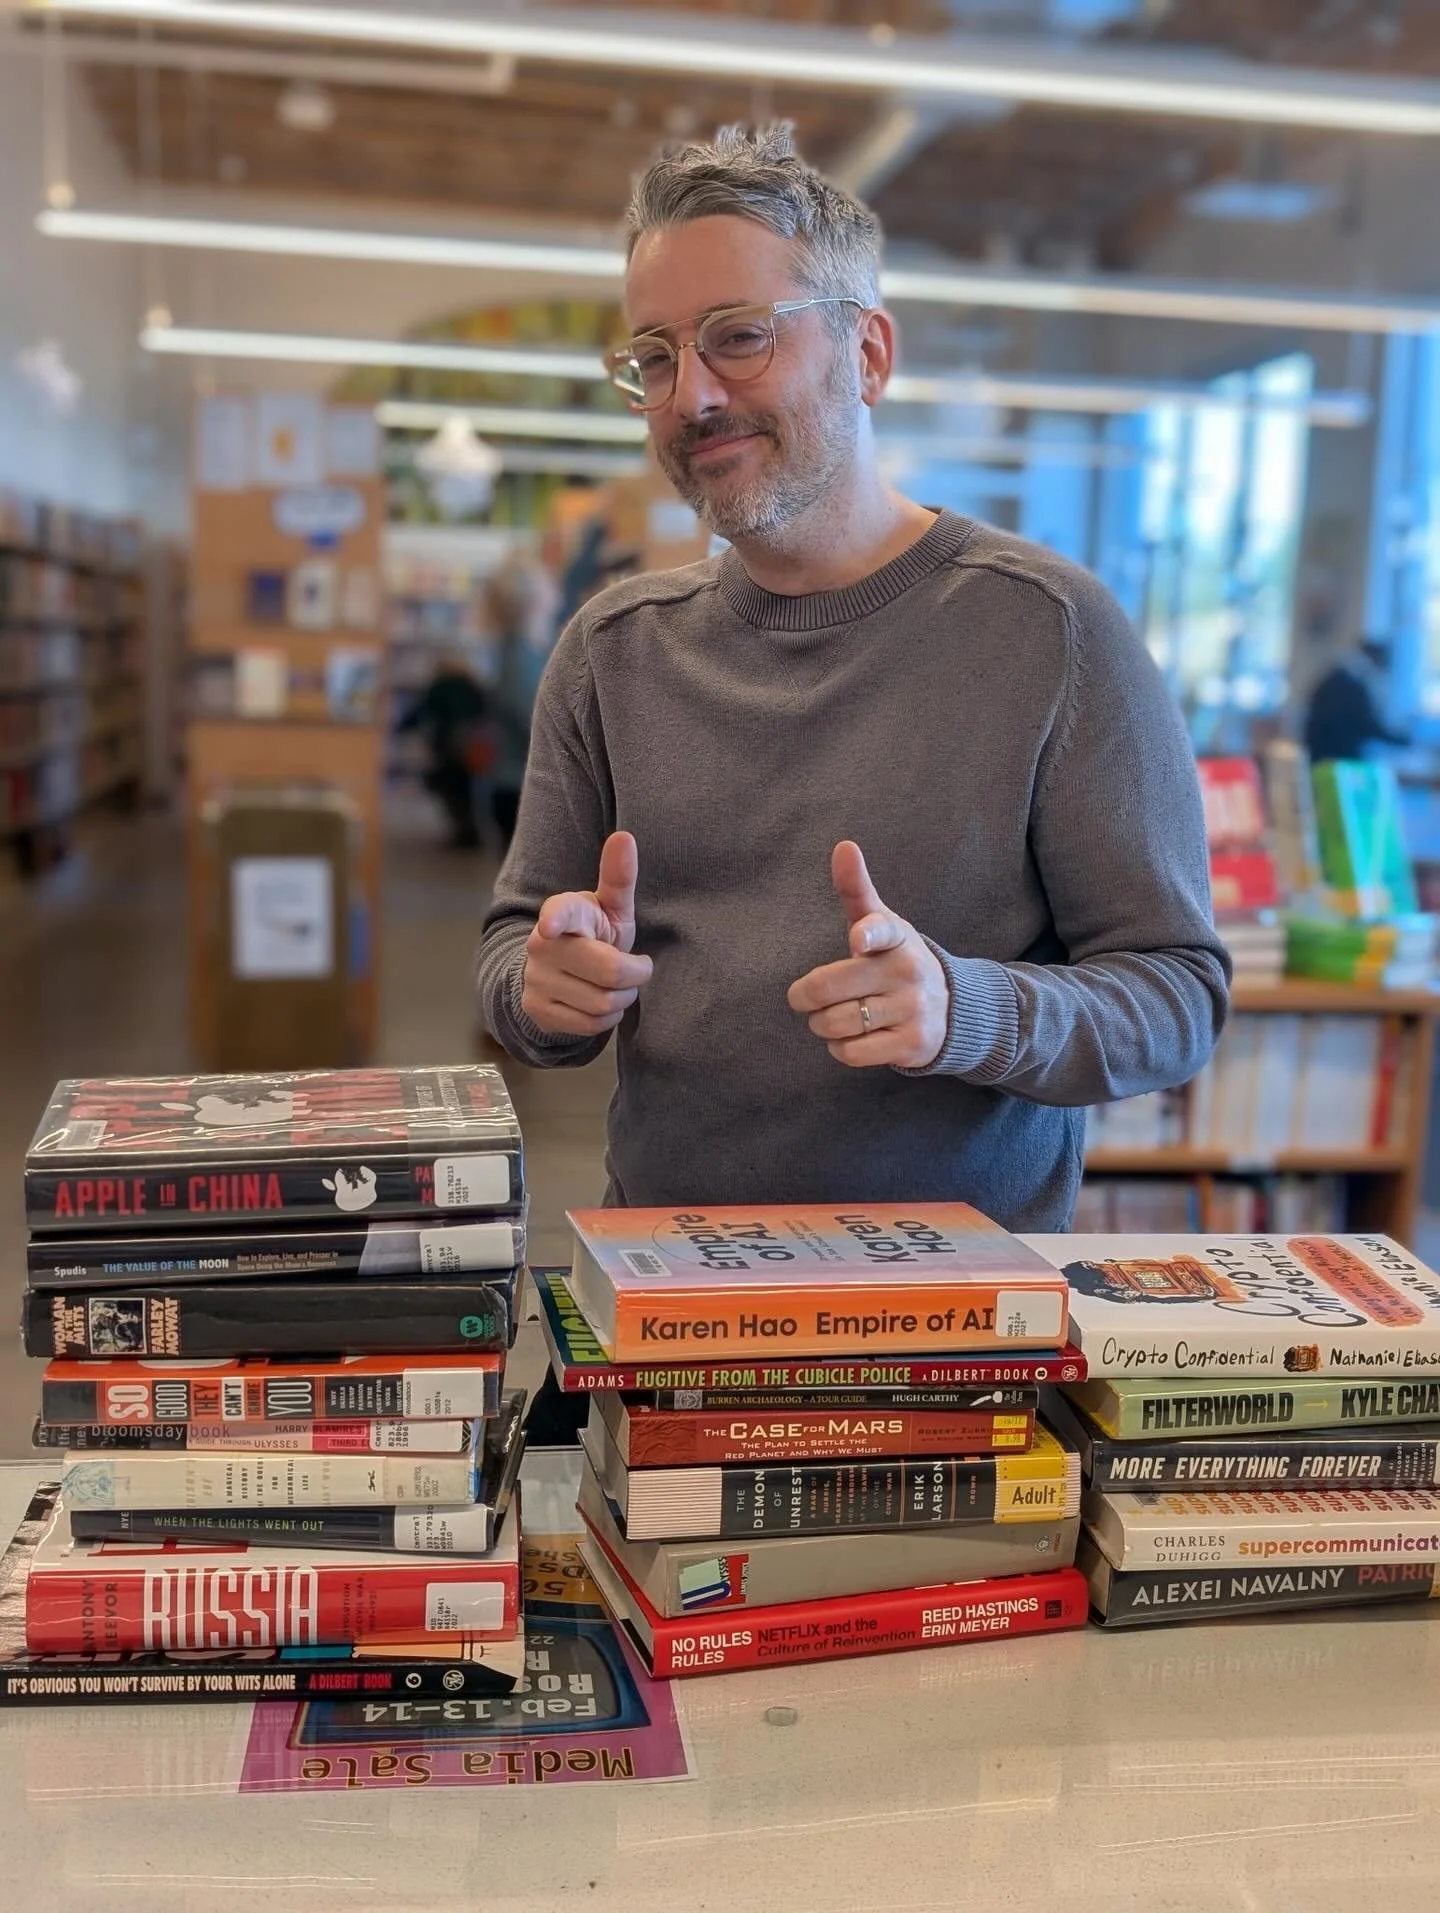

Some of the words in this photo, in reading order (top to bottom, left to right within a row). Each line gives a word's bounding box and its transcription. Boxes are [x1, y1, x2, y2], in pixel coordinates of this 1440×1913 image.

[55, 1178, 147, 1218] APPLE
[189, 1173, 283, 1213] CHINA
[671, 1213, 752, 1270] Empire
[719, 1222, 777, 1241] AI
[834, 1214, 918, 1263] Karen
[893, 1220, 957, 1254] Hao
[103, 1263, 123, 1273] THE
[125, 1262, 157, 1273] VALUE
[160, 1261, 174, 1271] OF
[176, 1260, 196, 1270] THE
[199, 1258, 229, 1269] MOON
[738, 1242, 796, 1262] of
[54, 1266, 87, 1278] Spudis
[1206, 1248, 1301, 1316] Crypto
[1225, 1238, 1368, 1327] Confidential
[53, 1296, 66, 1355] WOMAN
[65, 1309, 73, 1329] THE
[73, 1306, 85, 1345] MISTS
[150, 1299, 164, 1354] FARLEY
[164, 1297, 179, 1356] MOWAT
[641, 1317, 729, 1341] Karen
[739, 1314, 798, 1338] Hao
[816, 1309, 918, 1338] Empire
[926, 1308, 956, 1332] of
[962, 1307, 994, 1331] AI
[1102, 1337, 1169, 1369] Crypto
[1175, 1340, 1274, 1369] Confidential
[1330, 1347, 1401, 1366] Nathaniel
[1403, 1348, 1440, 1367] Elias
[578, 1374, 624, 1388] ADAMS
[636, 1370, 706, 1388] FUGITIVE
[712, 1369, 757, 1387] FROM
[762, 1369, 789, 1386] THE
[795, 1368, 854, 1386] CUBICLE
[860, 1367, 911, 1384] POLICE
[922, 1374, 927, 1382] A
[931, 1369, 986, 1382] DILBERT
[995, 1369, 1029, 1381] BOOK
[108, 1384, 149, 1419] SO
[155, 1383, 188, 1418] GOOD
[195, 1383, 220, 1417] THEY
[224, 1383, 242, 1416] CAN'T
[267, 1381, 313, 1417] YOU
[707, 1396, 740, 1405] BURREN
[741, 1396, 803, 1405] ARCHAEOLOGY
[816, 1395, 840, 1403] TOUR
[841, 1394, 867, 1403] GUIDE
[892, 1394, 920, 1402] HUGH
[922, 1394, 959, 1402] CARTHY
[1141, 1393, 1293, 1430] FILTERWORLD
[1340, 1387, 1394, 1418] KYLE
[1396, 1384, 1440, 1415] CHA
[91, 1422, 184, 1440] bloomsday
[190, 1423, 231, 1438] book
[275, 1425, 308, 1433] HARRY
[803, 1425, 825, 1433] FOR
[218, 1438, 252, 1446] THROUGH
[254, 1440, 298, 1449] ULYSSES
[1110, 1457, 1165, 1480] MORE
[1175, 1456, 1290, 1479] EVERYTHING
[1299, 1455, 1382, 1478] FOREVER
[737, 1489, 745, 1512] THE
[753, 1470, 765, 1528] DEMON
[774, 1491, 782, 1507] OF
[790, 1467, 802, 1528] UNREST
[914, 1474, 924, 1510] ERIK
[932, 1462, 943, 1521] LARSON
[1012, 1485, 1056, 1505] Adult
[121, 1511, 129, 1529] NYE
[154, 1517, 187, 1528] WHEN
[193, 1517, 214, 1528] THE
[218, 1518, 259, 1529] LIGHTS
[264, 1519, 297, 1530] WENT
[302, 1520, 324, 1531] OUT
[1154, 1535, 1225, 1548] CHARLES
[1238, 1533, 1440, 1558] supercommunicat
[1155, 1552, 1222, 1562] DUHIGG
[1132, 1579, 1221, 1606] ALEXEI
[1231, 1568, 1345, 1597] NAVALNY
[81, 1580, 95, 1655] ANTONY
[105, 1582, 119, 1649] BEEVOR
[144, 1566, 318, 1649] RUSSIA
[922, 1606, 962, 1624] REED
[965, 1597, 1038, 1619] HASTINGS
[758, 1624, 820, 1644] NETFLIX
[825, 1620, 850, 1636] and
[854, 1618, 878, 1632] the
[921, 1623, 956, 1638] ERIN
[959, 1616, 1010, 1634] MEYER
[672, 1638, 696, 1654] NO
[700, 1631, 752, 1651] RULES
[757, 1641, 811, 1657] Culture
[814, 1637, 829, 1651] of
[832, 1629, 916, 1649] Reinvention
[672, 1651, 725, 1668] RULES
[8, 1678, 27, 1694] IT'S
[30, 1677, 76, 1693] OBVIOUS
[79, 1677, 100, 1693] YOU
[104, 1676, 139, 1692] WON'T
[141, 1675, 185, 1692] SURVIVE
[188, 1675, 201, 1691] BY
[204, 1675, 232, 1691] YOUR
[235, 1675, 261, 1691] WITS
[263, 1675, 296, 1690] ALONE
[308, 1674, 317, 1689] A
[319, 1674, 358, 1689] DILBERT
[364, 1674, 392, 1688] BOOK
[303, 1750, 433, 1789] Sale
[464, 1749, 635, 1785] Media
